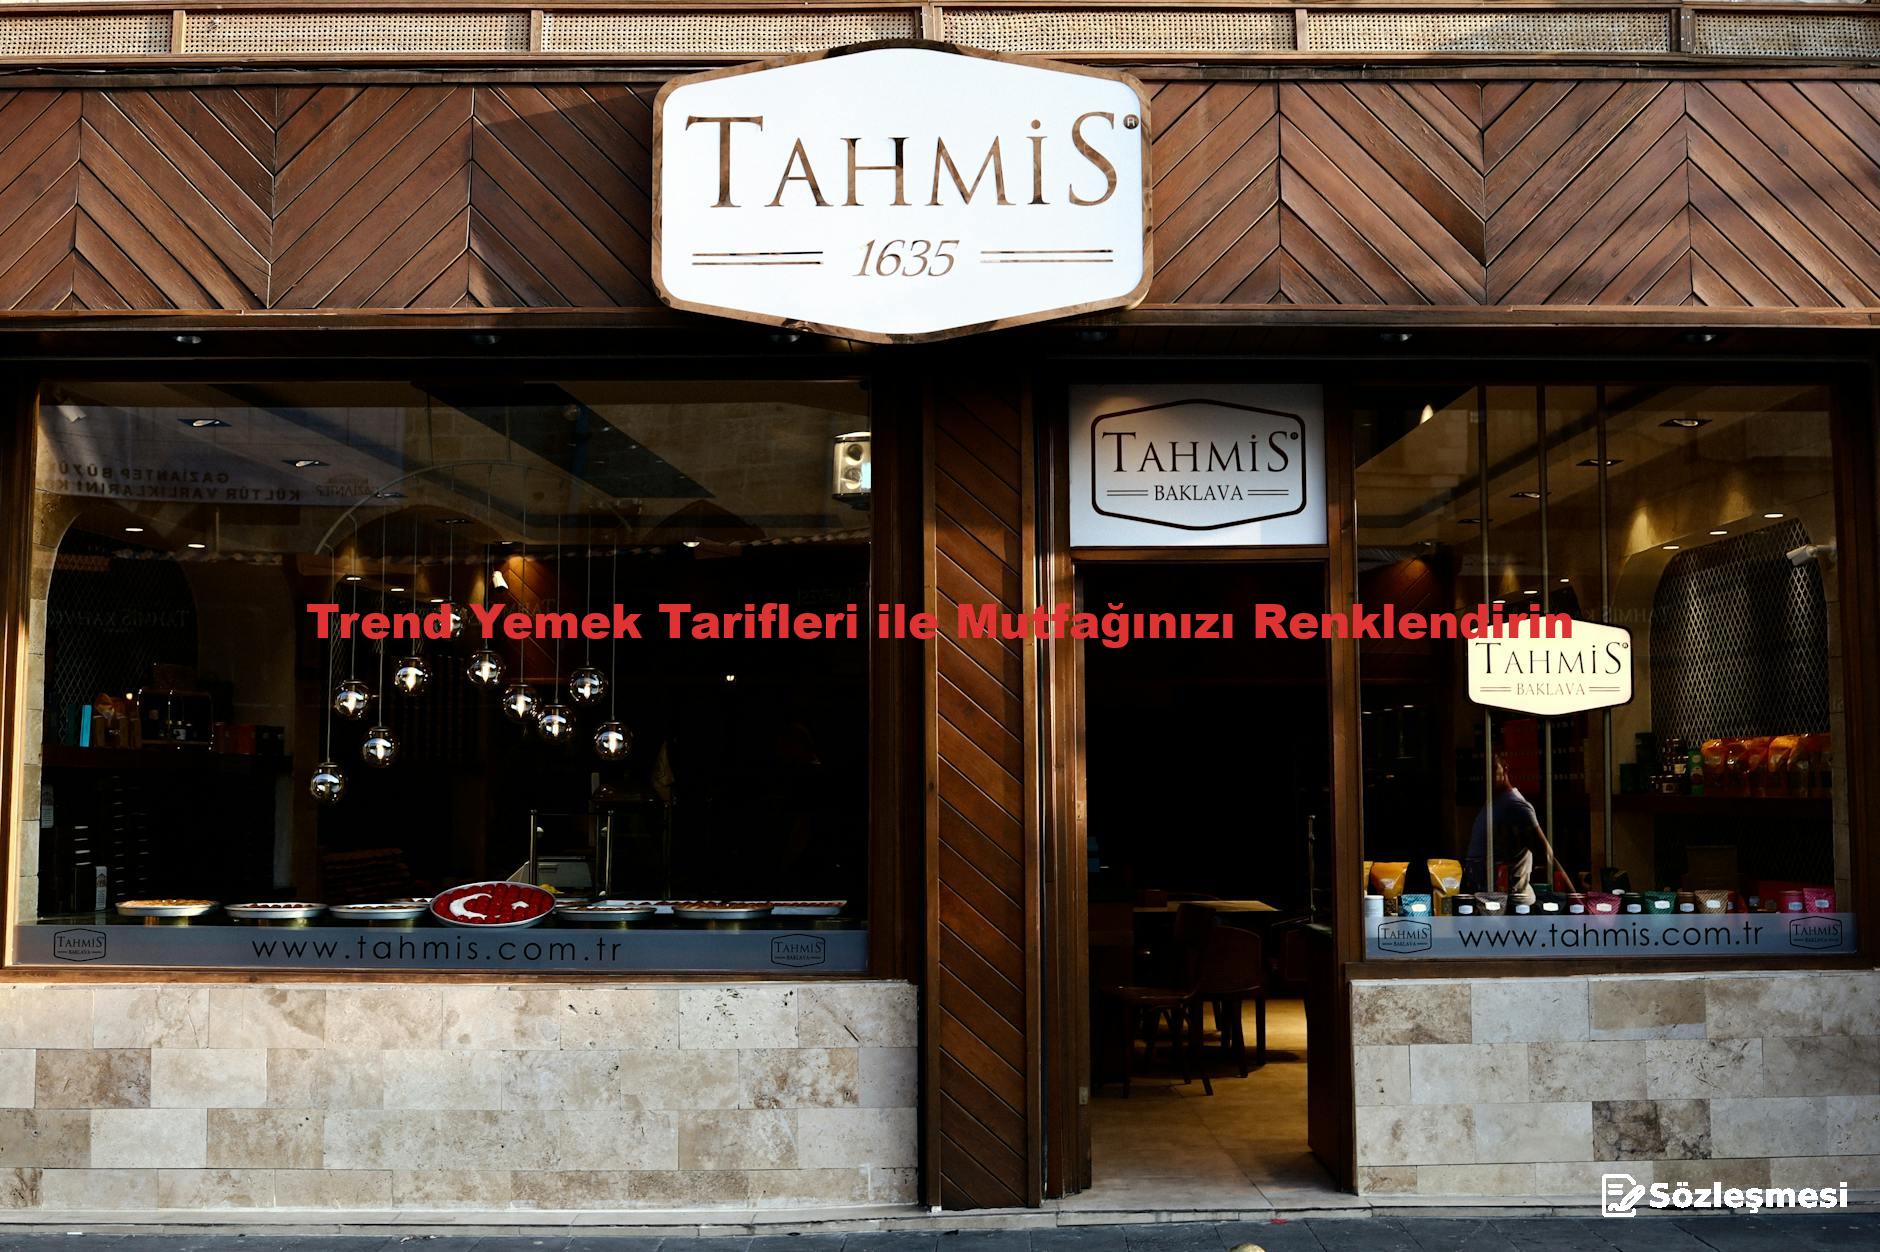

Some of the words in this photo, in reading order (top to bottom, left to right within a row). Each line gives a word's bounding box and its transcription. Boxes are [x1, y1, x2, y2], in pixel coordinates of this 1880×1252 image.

[852, 239, 960, 278] 1635
[1154, 485, 1244, 501] BAKLAVA
[1517, 682, 1586, 696] BAKLAVA
[1458, 921, 1763, 948] www.tahmis.com.tr
[252, 935, 621, 962] www.tahmis.com.tr
